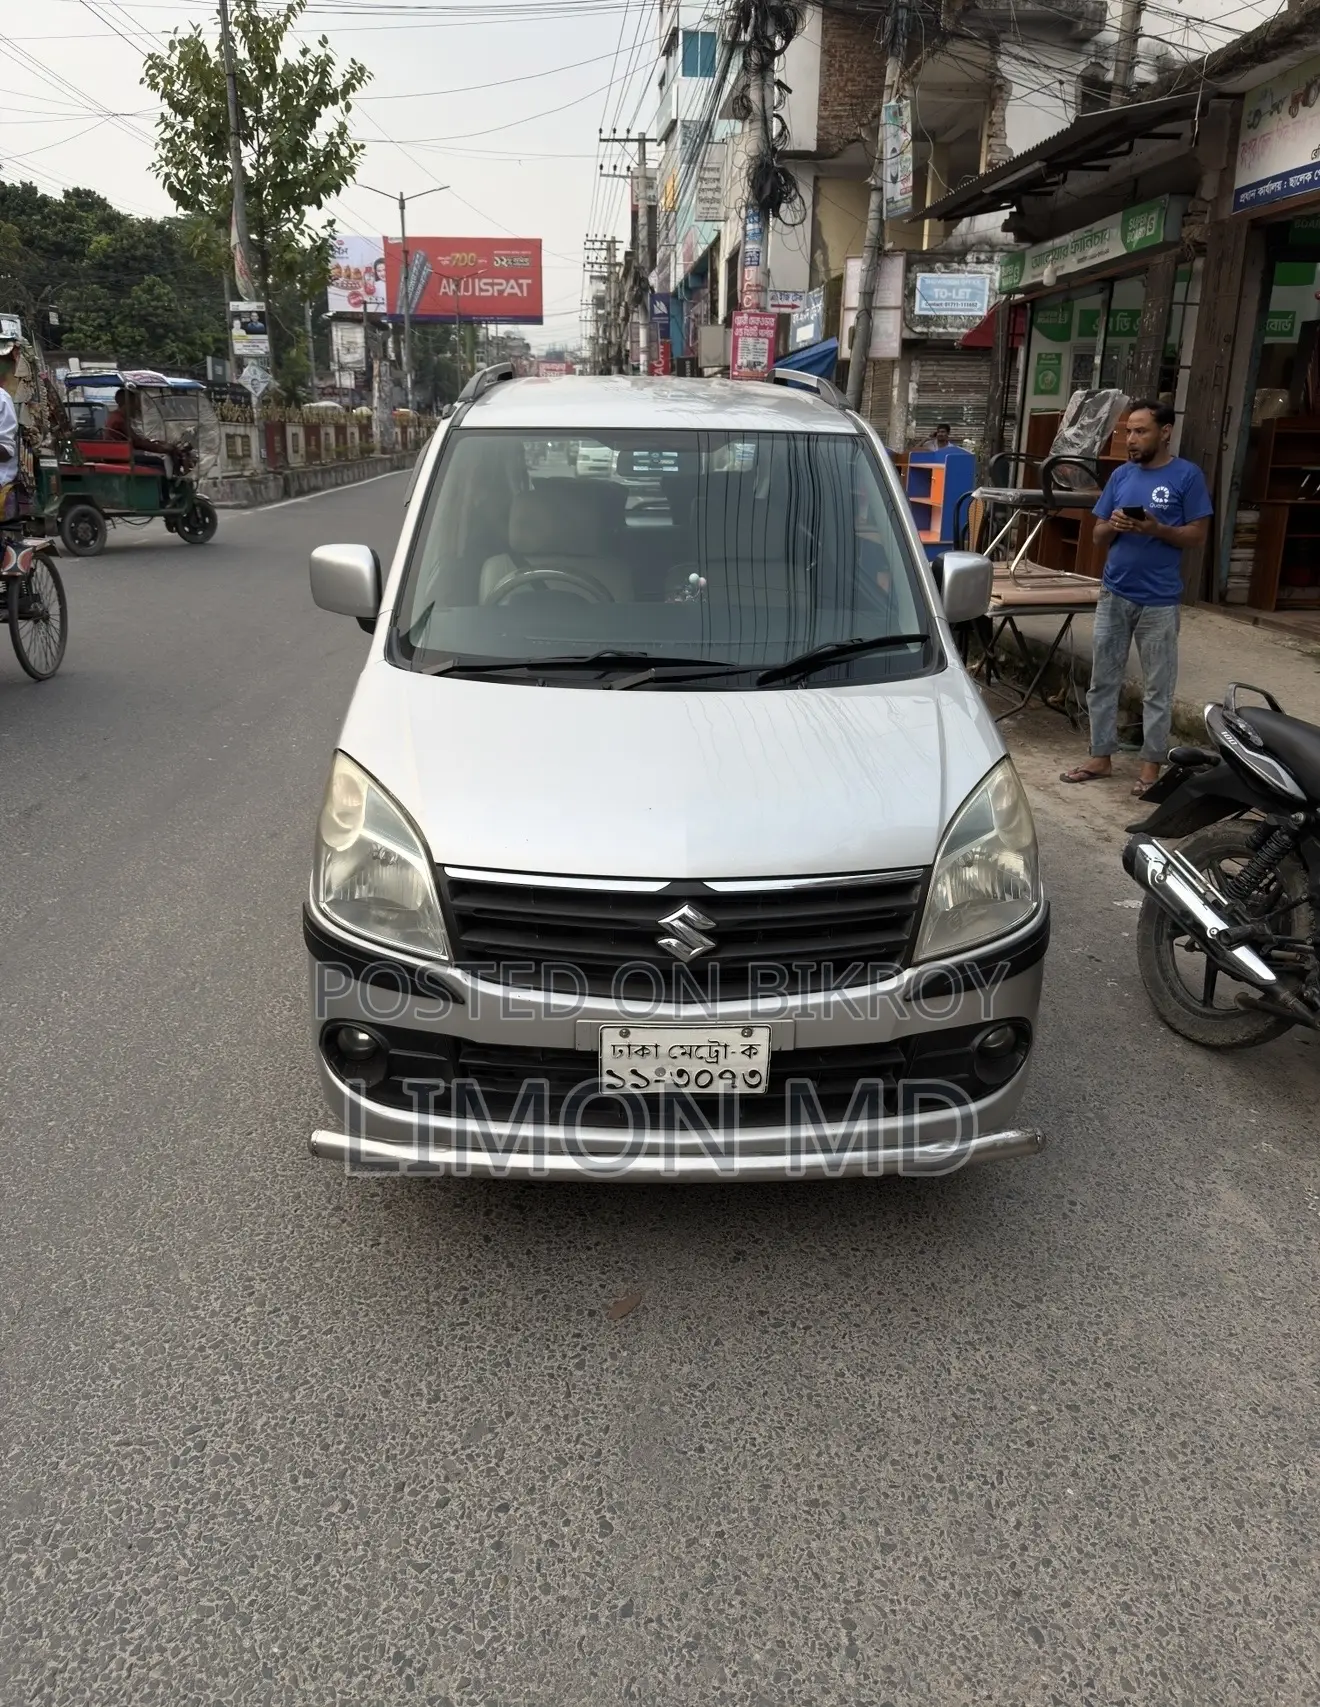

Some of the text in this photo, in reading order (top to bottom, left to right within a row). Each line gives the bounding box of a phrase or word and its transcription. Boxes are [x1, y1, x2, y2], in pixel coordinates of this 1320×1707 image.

[474, 278, 532, 297] ISPAT
[933, 288, 972, 300] TO-LET
[611, 1040, 661, 1060] ঢাকা
[605, 1067, 763, 1089] ১১-৩০৭৩
